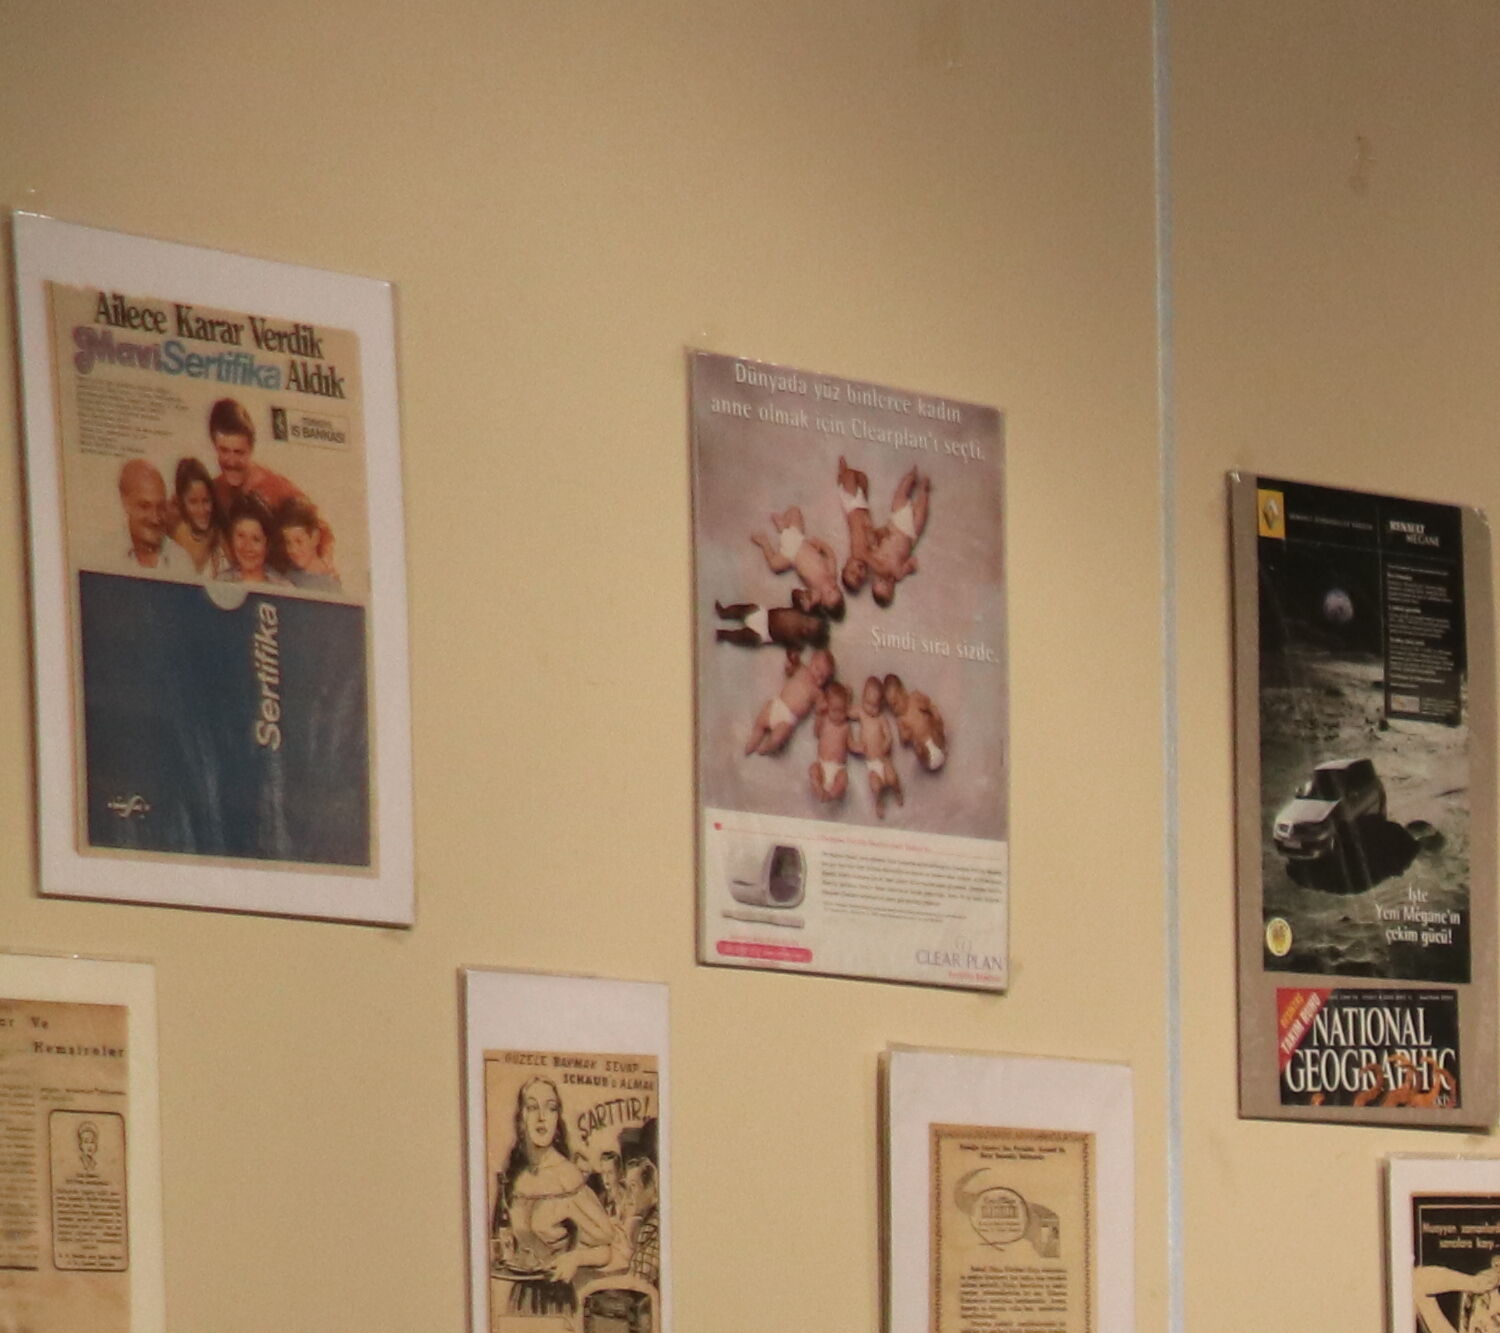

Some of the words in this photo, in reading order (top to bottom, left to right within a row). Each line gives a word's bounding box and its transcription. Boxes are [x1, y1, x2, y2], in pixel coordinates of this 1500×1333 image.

[95, 290, 168, 334] Ailece
[174, 303, 245, 346] Karar
[249, 316, 325, 360] Verdik
[285, 360, 347, 399] Aldık
[735, 362, 807, 394] Dünyada
[814, 378, 841, 401] yüz
[847, 383, 912, 414] binlerce
[918, 397, 961, 424] kadın
[711, 397, 752, 419] anne
[759, 403, 809, 429] olmak
[816, 411, 846, 436] için
[851, 417, 939, 451] Clearplan'ı
[869, 626, 917, 653] Şimdi
[921, 637, 951, 657] sıra
[255, 601, 282, 751] Sertifika
[1375, 903, 1400, 920] Yeni
[1385, 926, 1418, 944] çekim
[1421, 927, 1453, 947] gücü!
[915, 949, 961, 967] CLEAR
[966, 953, 1003, 971] PLAN
[1313, 1007, 1432, 1046] NATIONAL
[577, 1095, 650, 1146] ŞARTTIR!
